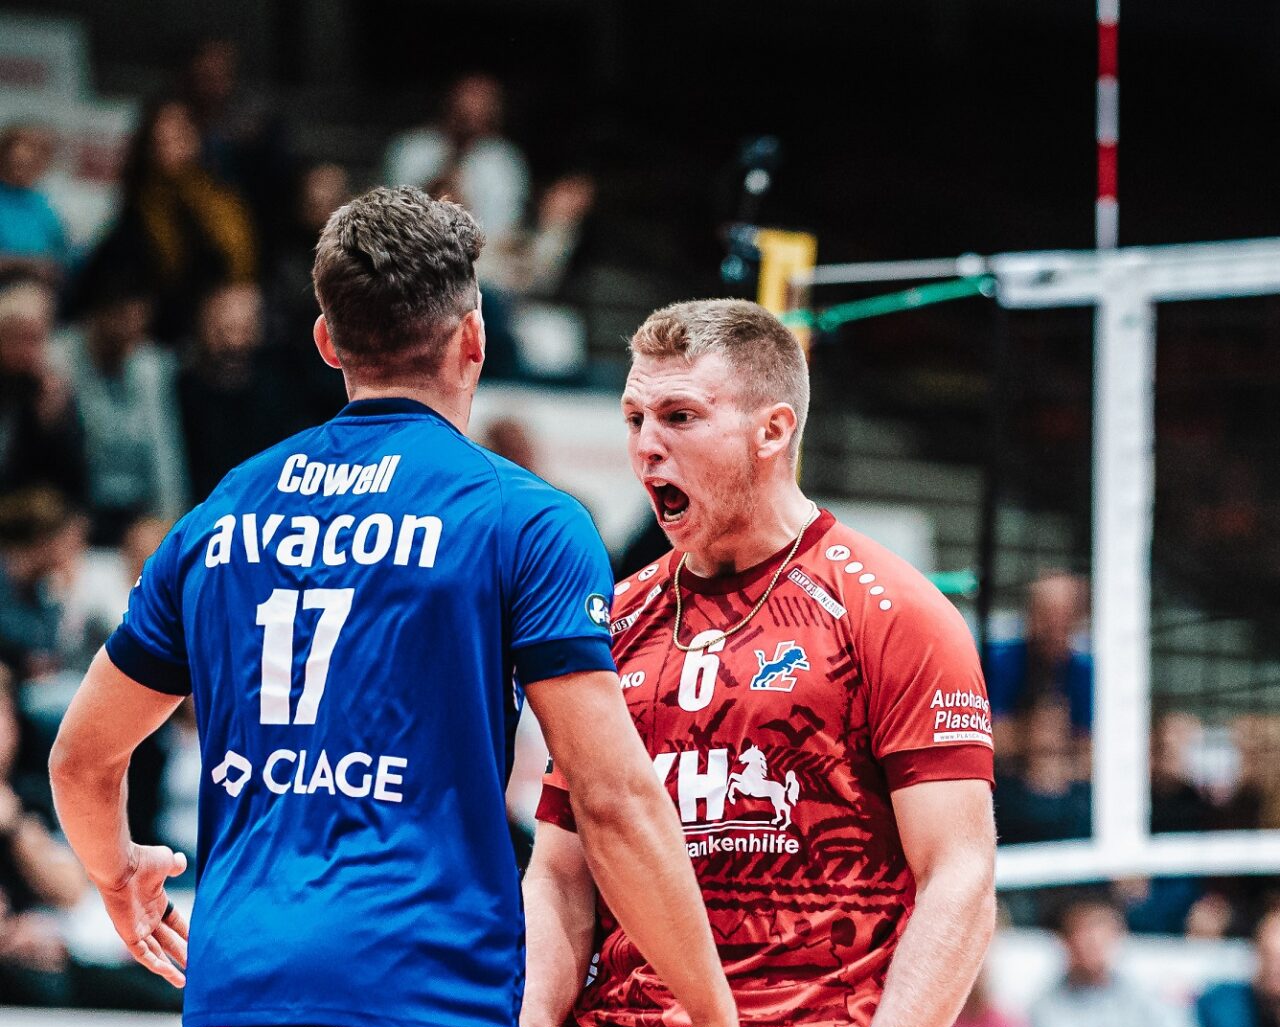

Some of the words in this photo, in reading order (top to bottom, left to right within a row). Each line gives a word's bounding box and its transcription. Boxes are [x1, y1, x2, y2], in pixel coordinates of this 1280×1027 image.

[277, 453, 400, 497] Cowell
[205, 512, 443, 569] avacon
[255, 588, 355, 725] 17
[619, 671, 646, 689] KO
[678, 628, 726, 712] 6
[930, 688, 990, 714] Autohaus
[934, 710, 992, 734] Plaschka
[262, 750, 408, 803] CLAGE
